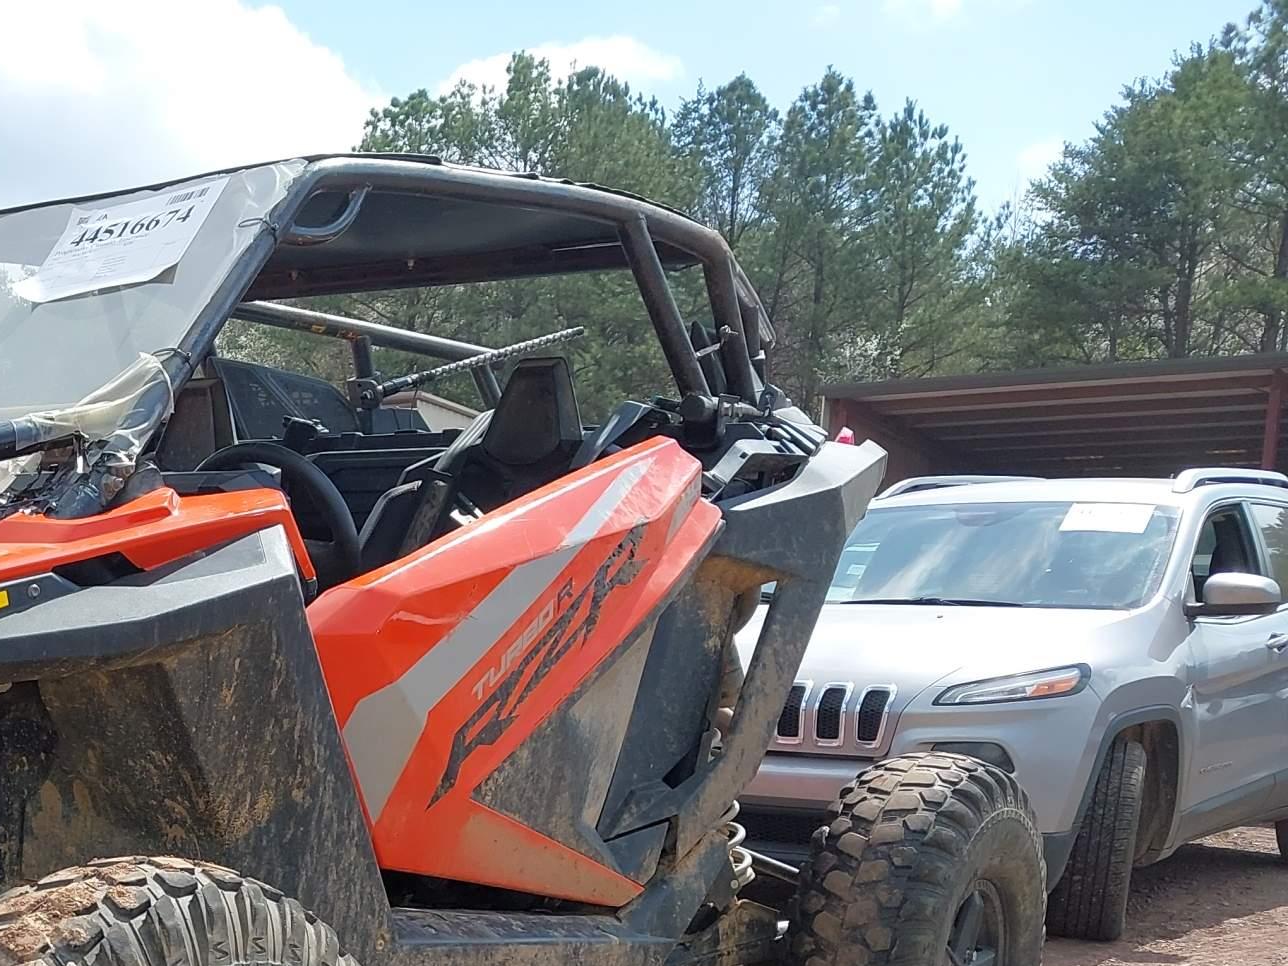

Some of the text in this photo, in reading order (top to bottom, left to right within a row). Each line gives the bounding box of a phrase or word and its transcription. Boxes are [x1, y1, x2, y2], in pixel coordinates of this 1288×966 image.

[69, 203, 196, 248] 44516674
[425, 517, 650, 813] RZR
[471, 575, 576, 700] TURBO R
